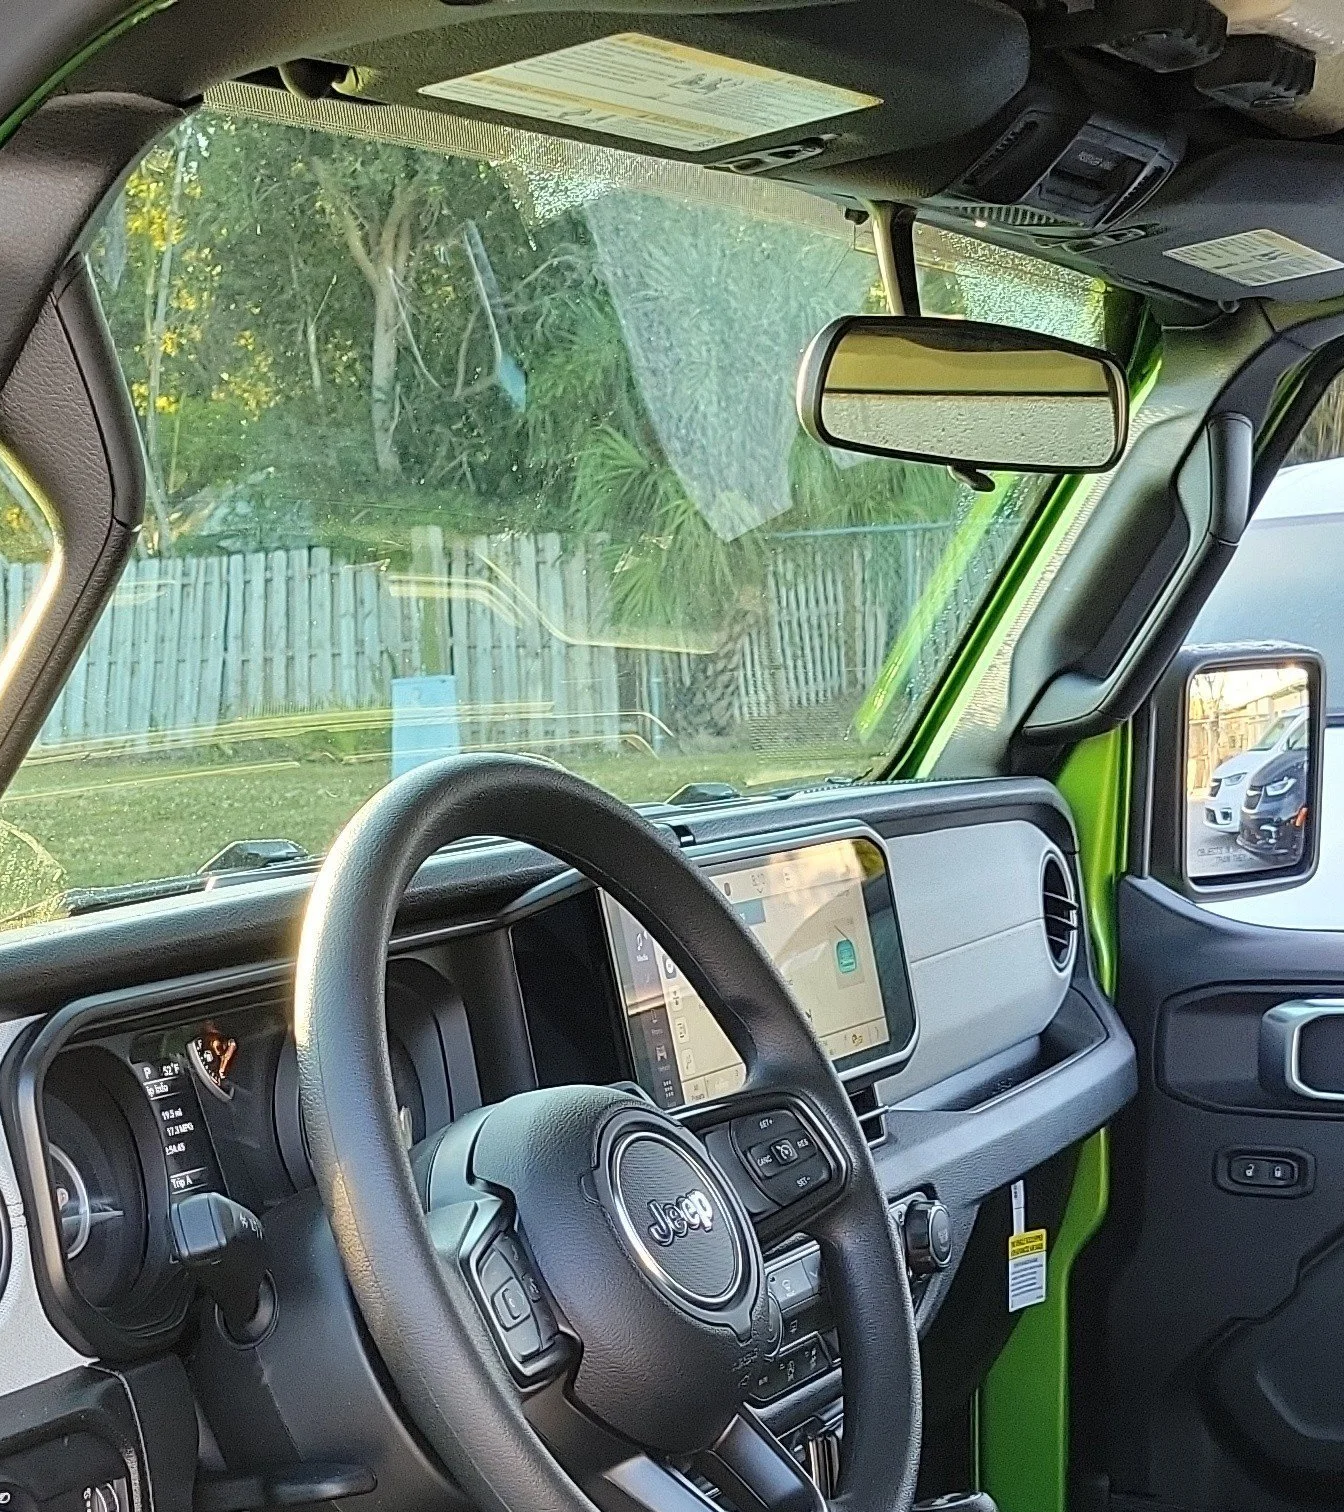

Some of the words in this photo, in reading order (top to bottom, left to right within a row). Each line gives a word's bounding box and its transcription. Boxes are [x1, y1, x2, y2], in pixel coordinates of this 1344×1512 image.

[171, 1177, 185, 1189] Trip
[186, 1174, 193, 1186] A
[646, 1188, 713, 1247] Jeep
